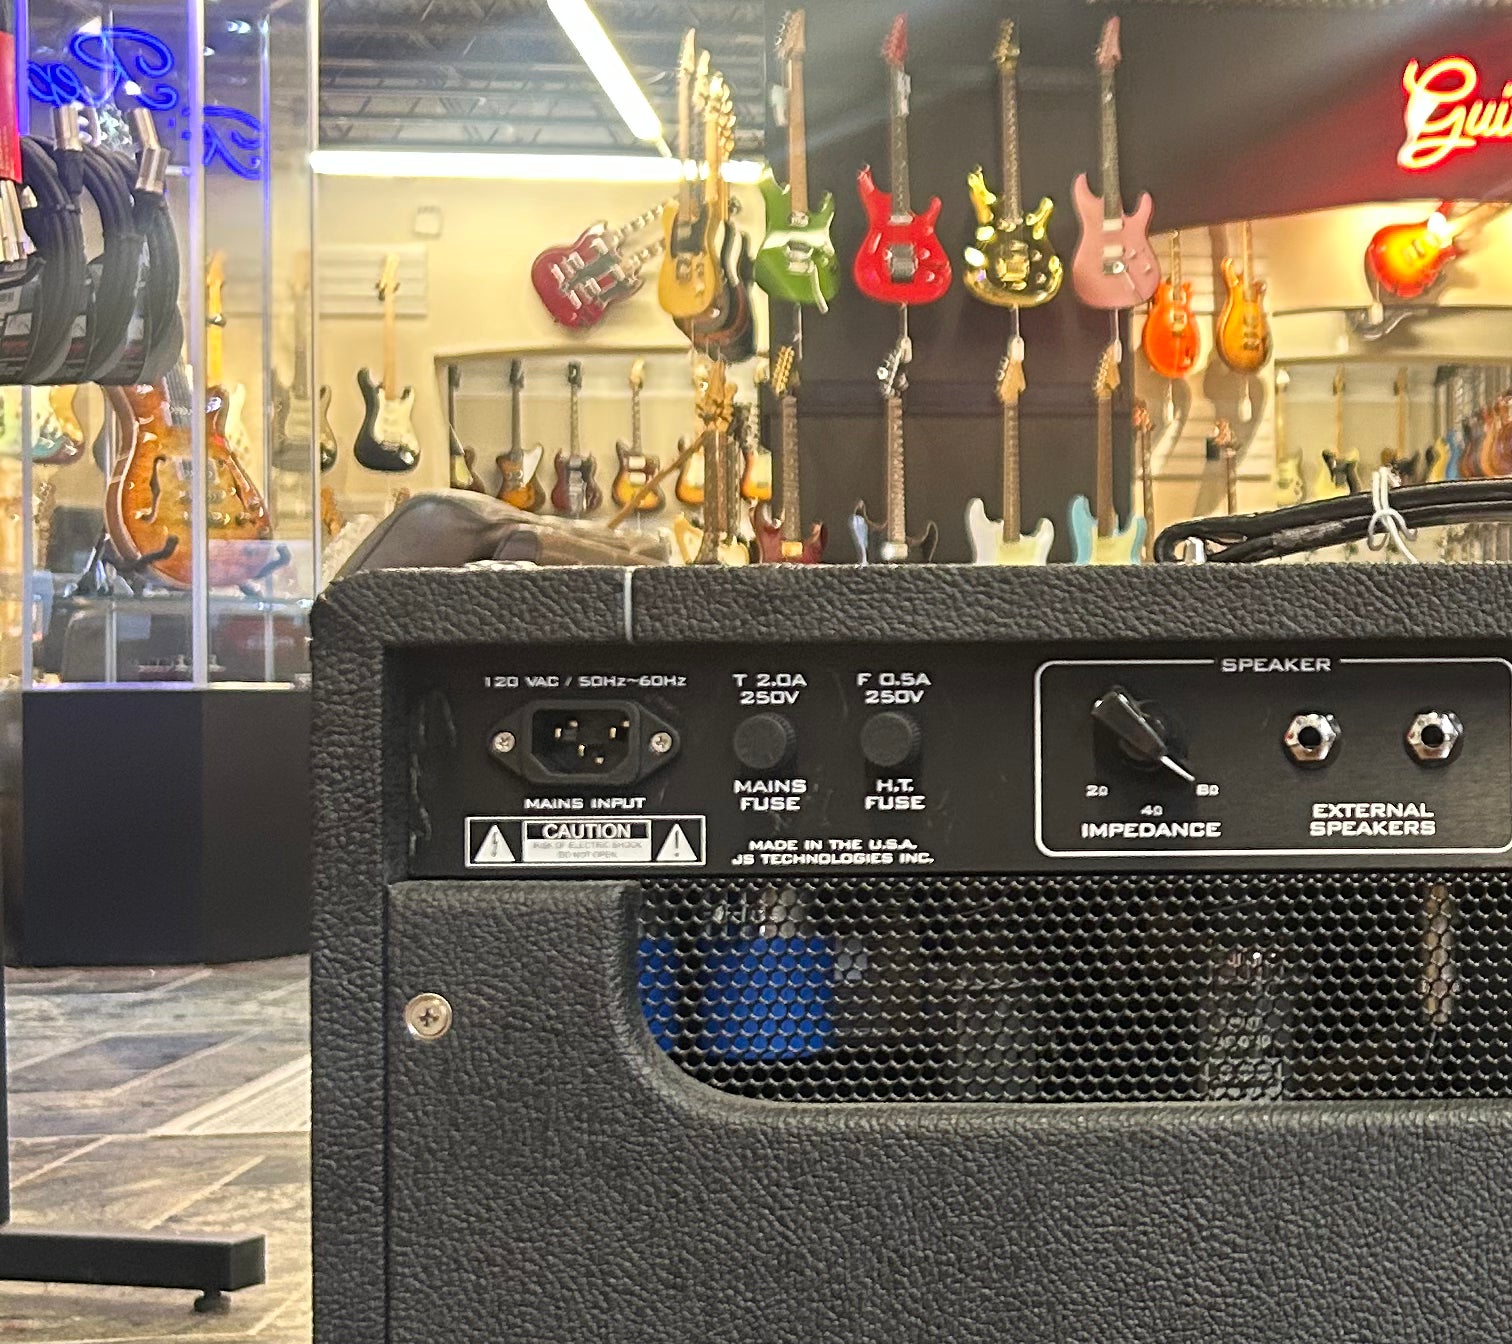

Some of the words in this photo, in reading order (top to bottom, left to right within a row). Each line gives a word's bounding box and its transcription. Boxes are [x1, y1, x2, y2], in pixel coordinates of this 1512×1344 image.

[1221, 658, 1331, 672] SPEAKER
[484, 676, 519, 687] 120
[525, 676, 560, 687] VAC
[732, 674, 748, 687] T
[756, 674, 807, 687] 2.0A
[857, 673, 872, 687] F
[880, 673, 931, 687] 0.5A
[740, 690, 799, 704] 250V
[864, 690, 924, 704] 250V
[733, 779, 807, 793] MAINS
[875, 778, 914, 792] H.T.
[523, 798, 583, 810] MAINS
[591, 798, 646, 810] INPUT
[740, 796, 801, 811] FUSE
[864, 795, 926, 810] FUSE
[1312, 803, 1434, 819] EXTERNAL
[541, 823, 632, 839] CAUTION
[1081, 822, 1221, 838] IMPEDANCE
[1310, 820, 1436, 837] SPEAKERS
[748, 839, 799, 851] MADE
[804, 839, 823, 851] IN
[829, 839, 863, 850] THE
[731, 854, 755, 866] JS
[760, 853, 893, 865] TECHNOLOGIES
